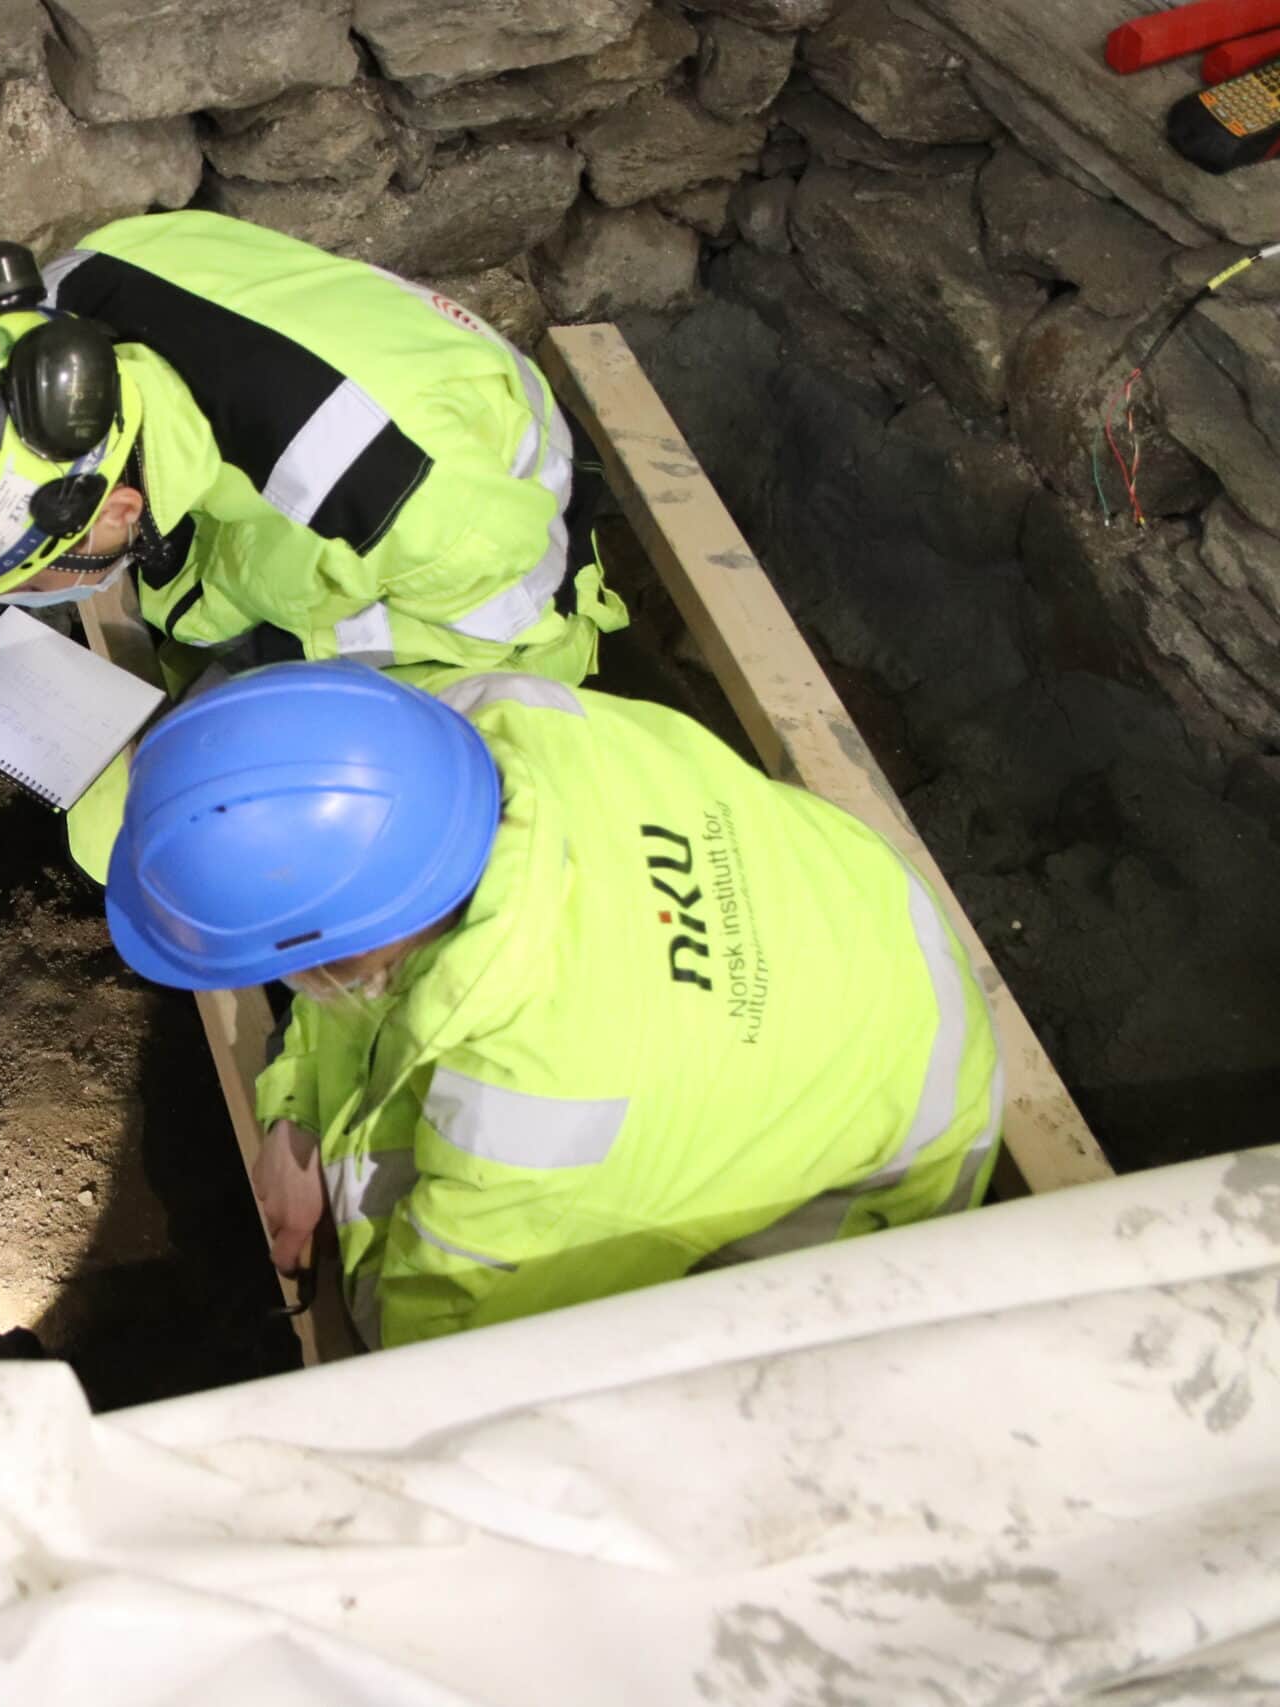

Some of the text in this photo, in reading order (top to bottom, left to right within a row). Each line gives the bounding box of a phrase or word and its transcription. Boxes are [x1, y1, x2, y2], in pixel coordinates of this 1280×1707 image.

[702, 810, 747, 1018] Norsk institutt for
